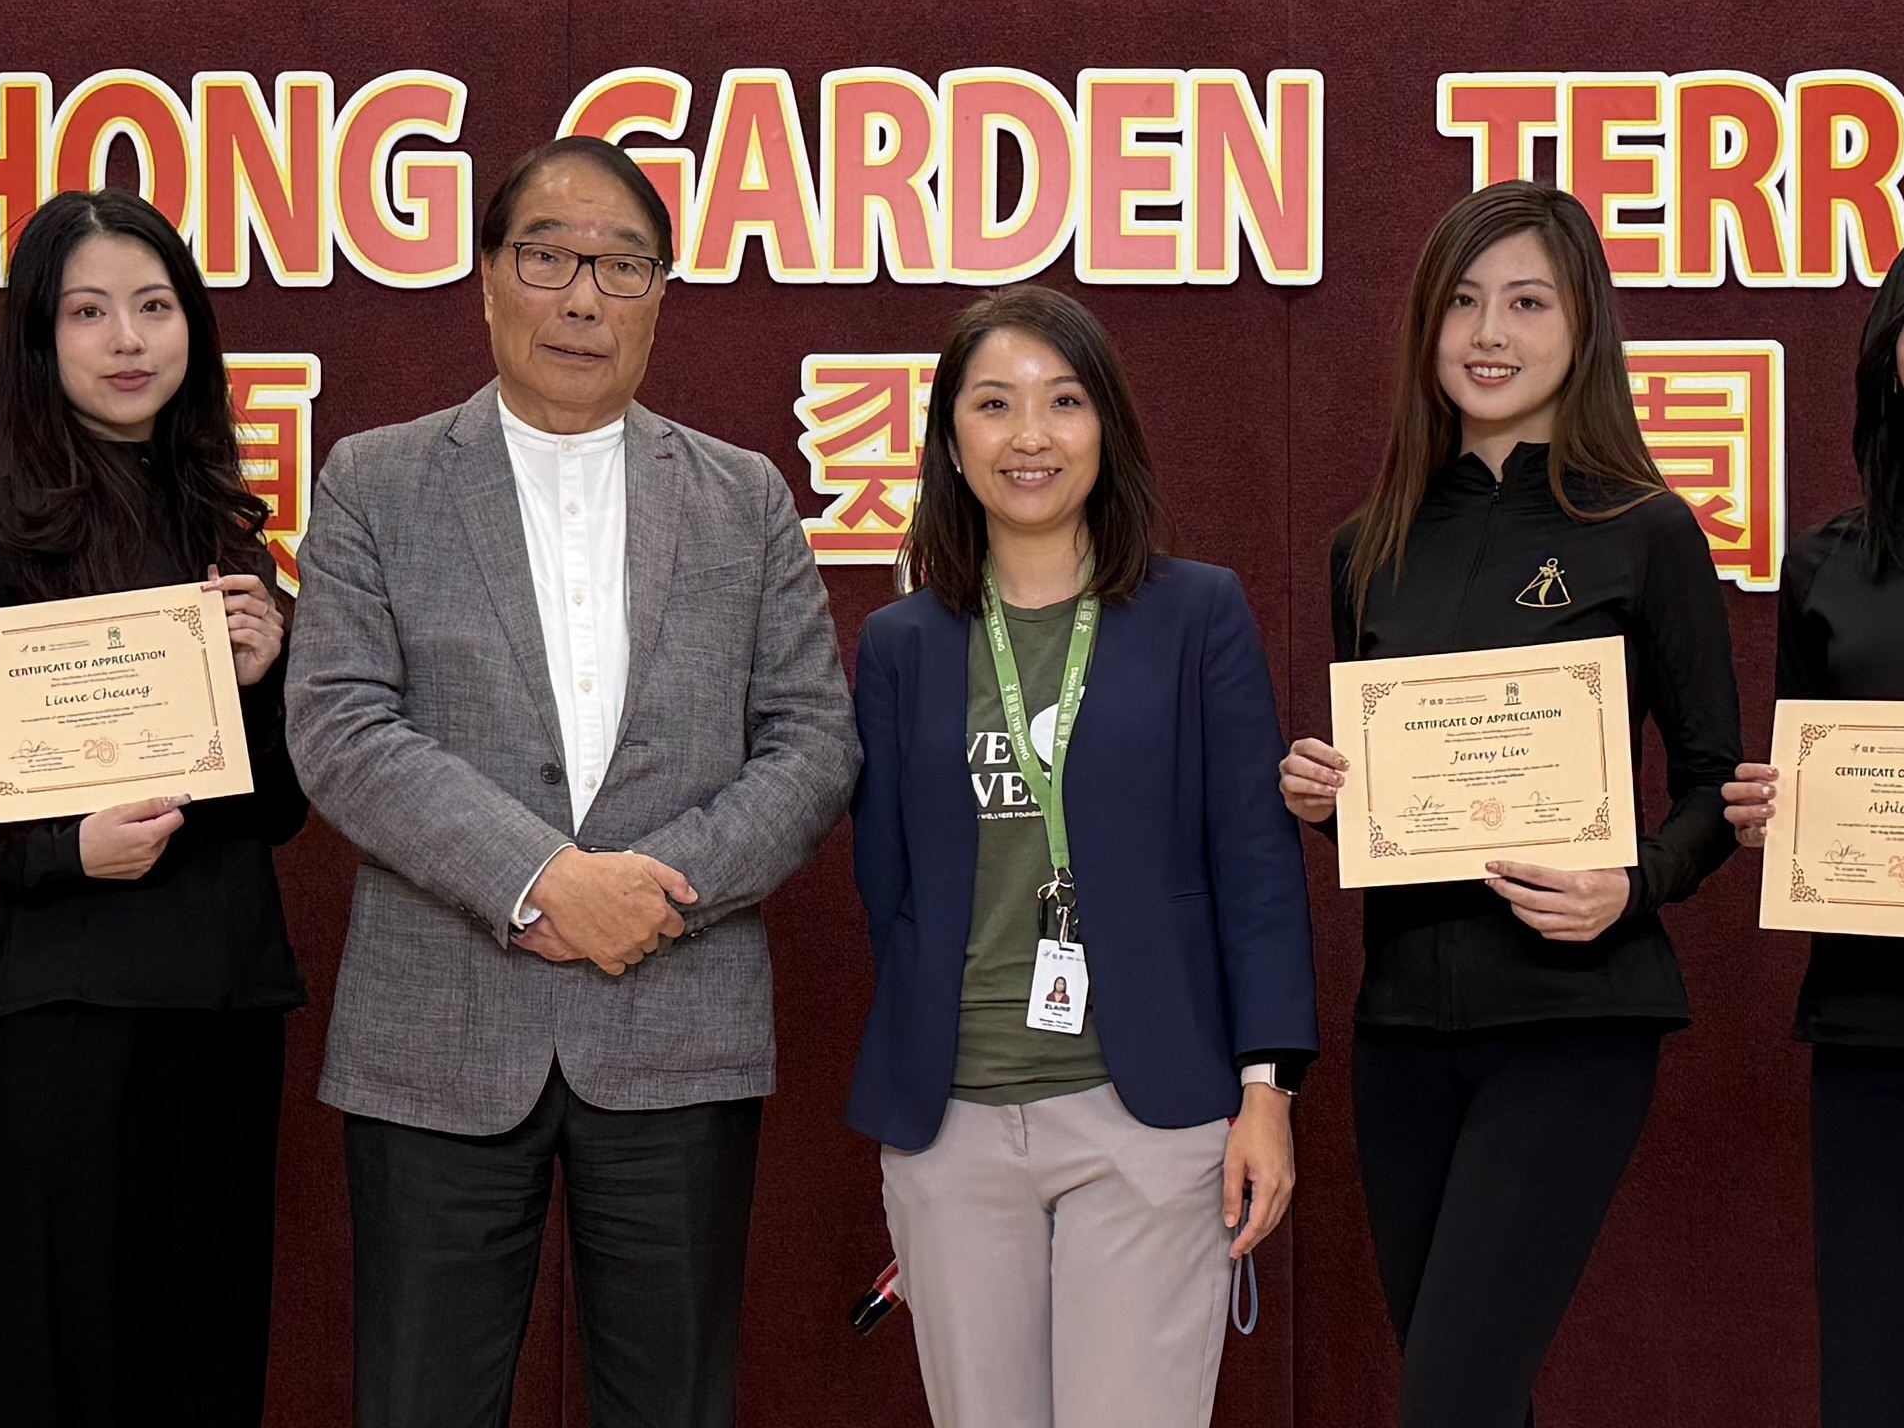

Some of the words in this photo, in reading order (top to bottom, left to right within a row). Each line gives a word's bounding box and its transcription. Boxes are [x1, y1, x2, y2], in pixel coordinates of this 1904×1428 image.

[8, 662, 72, 678] CERTIFICATE
[75, 658, 88, 670] OF
[91, 650, 166, 668] APPRECIATION
[92, 685, 154, 703] Cheung
[1404, 717, 1467, 731] CERTIFICATE
[1470, 715, 1483, 726] OF
[1486, 708, 1561, 725] APPRECIATION
[1835, 766, 1895, 778] CERTIFICATE
[971, 771, 1050, 808] VE
